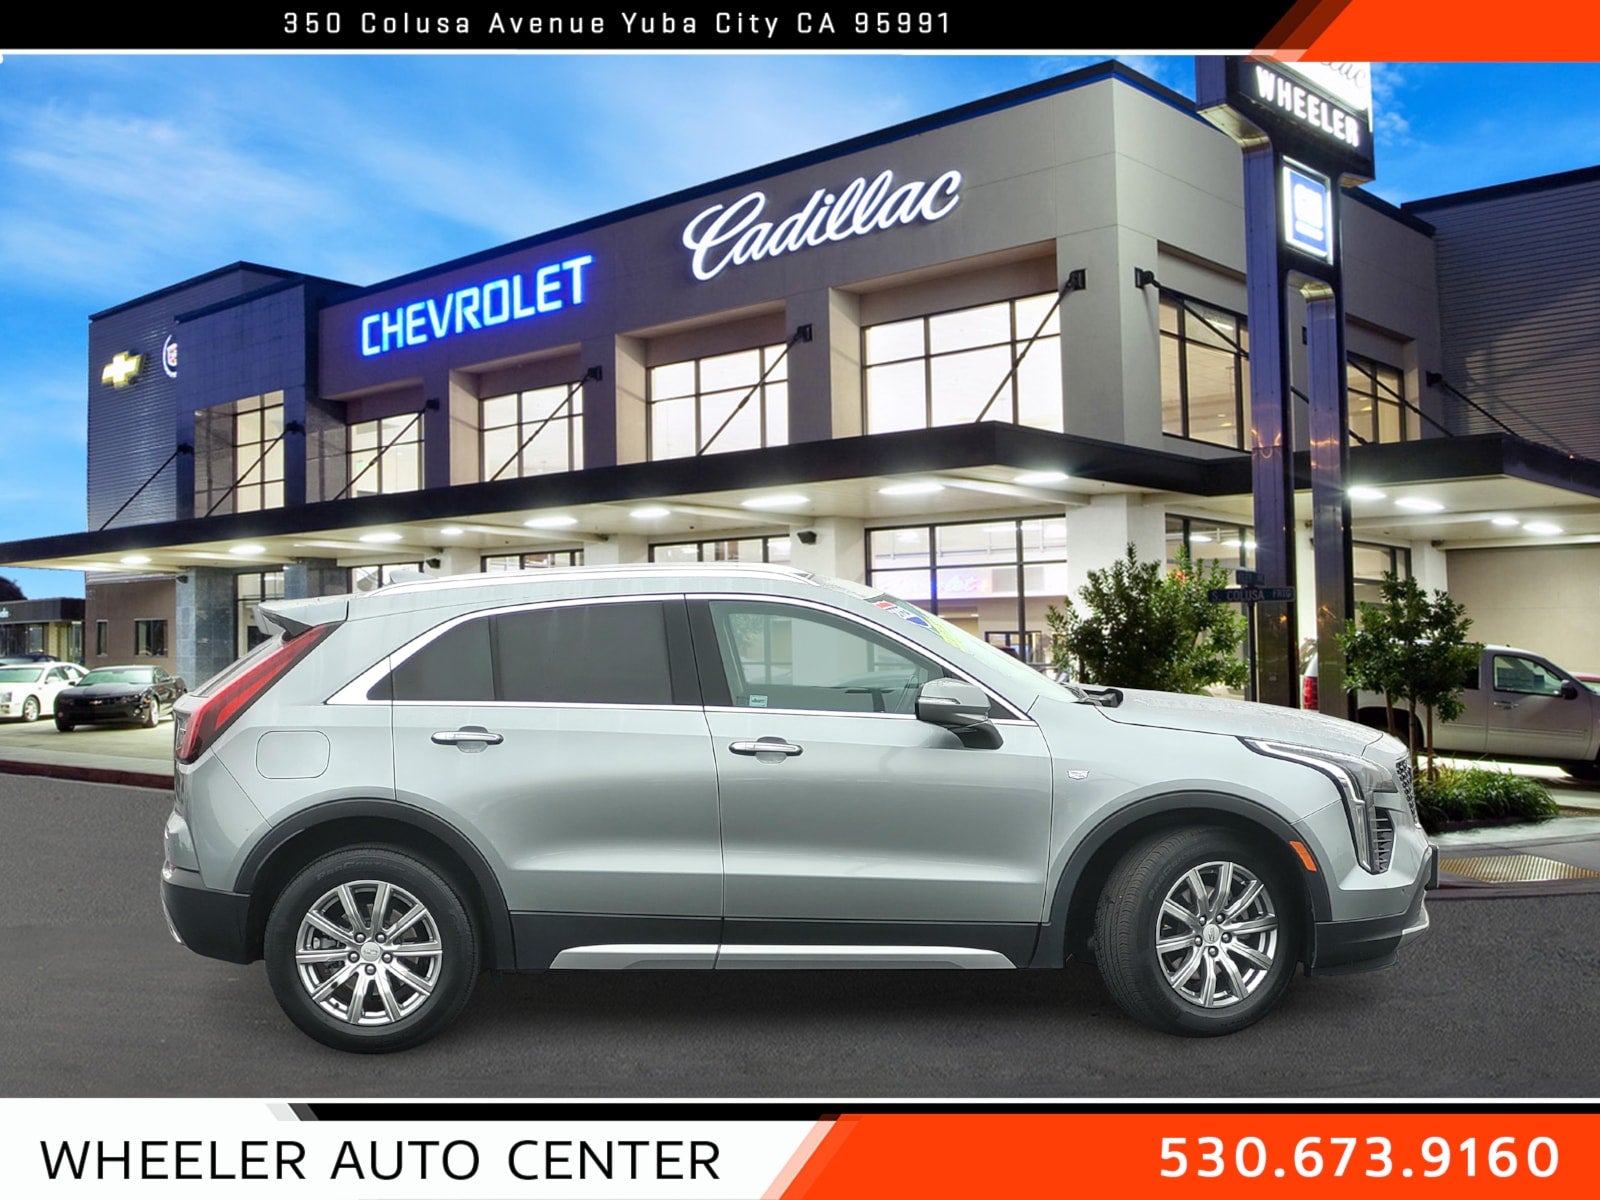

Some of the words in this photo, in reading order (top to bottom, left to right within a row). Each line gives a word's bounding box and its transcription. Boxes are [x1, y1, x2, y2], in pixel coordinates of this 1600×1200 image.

[1256, 64, 1359, 148] WHEELER
[682, 169, 962, 281] Cadillac
[361, 254, 594, 357] CHEVROLET
[1226, 590, 1265, 601] COLUSA
